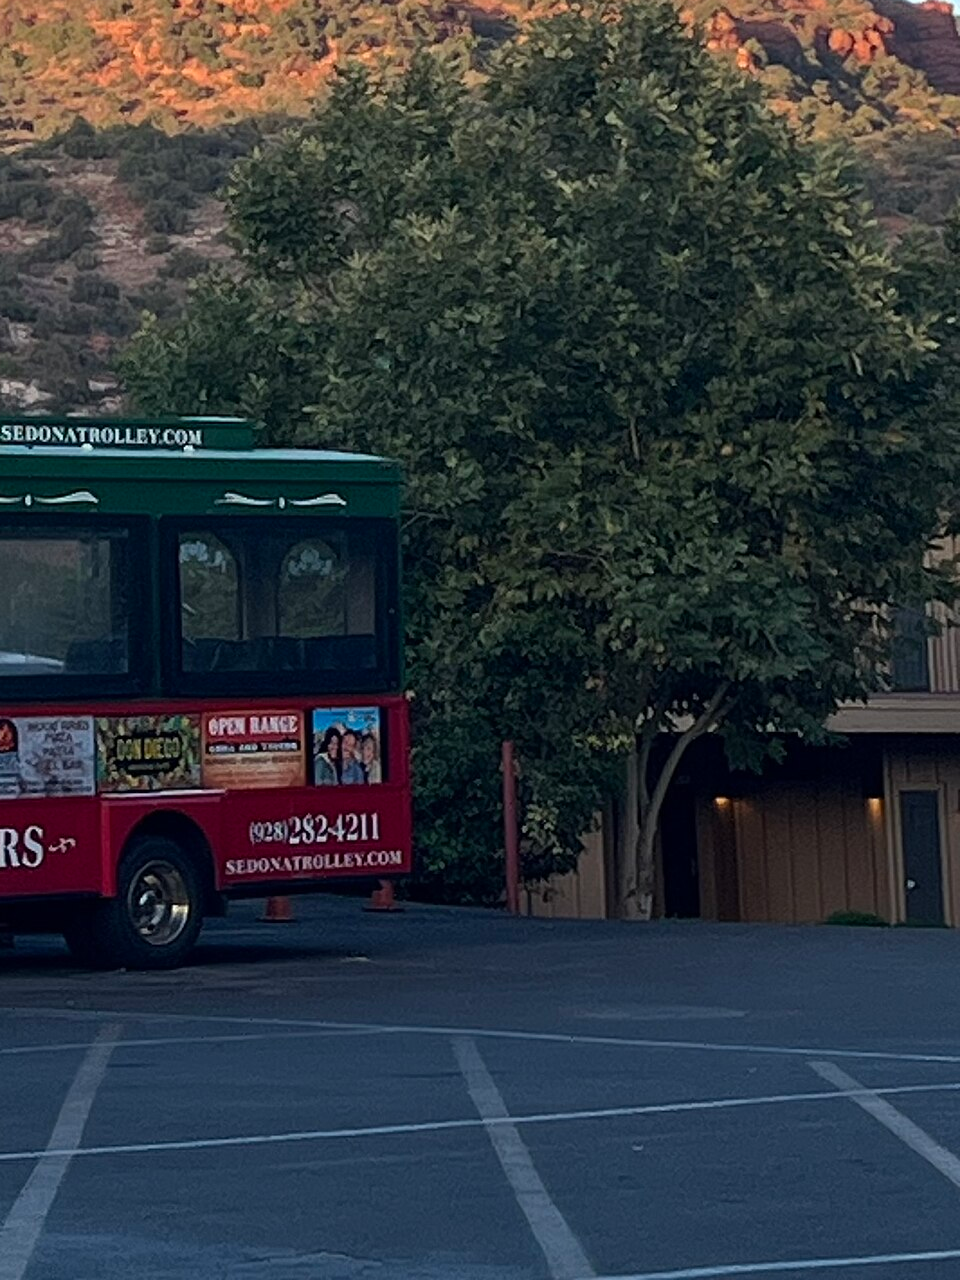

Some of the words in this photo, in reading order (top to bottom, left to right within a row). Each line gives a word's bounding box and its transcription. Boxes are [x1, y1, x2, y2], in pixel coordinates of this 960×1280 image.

[0, 425, 203, 446] SEDONATROLLEY.COM
[208, 716, 246, 736] OPEN
[249, 715, 298, 735] RANGE
[116, 738, 142, 761] DON
[143, 736, 180, 760] DIEGO
[225, 850, 403, 875] SEDONATROLLEY.COM
